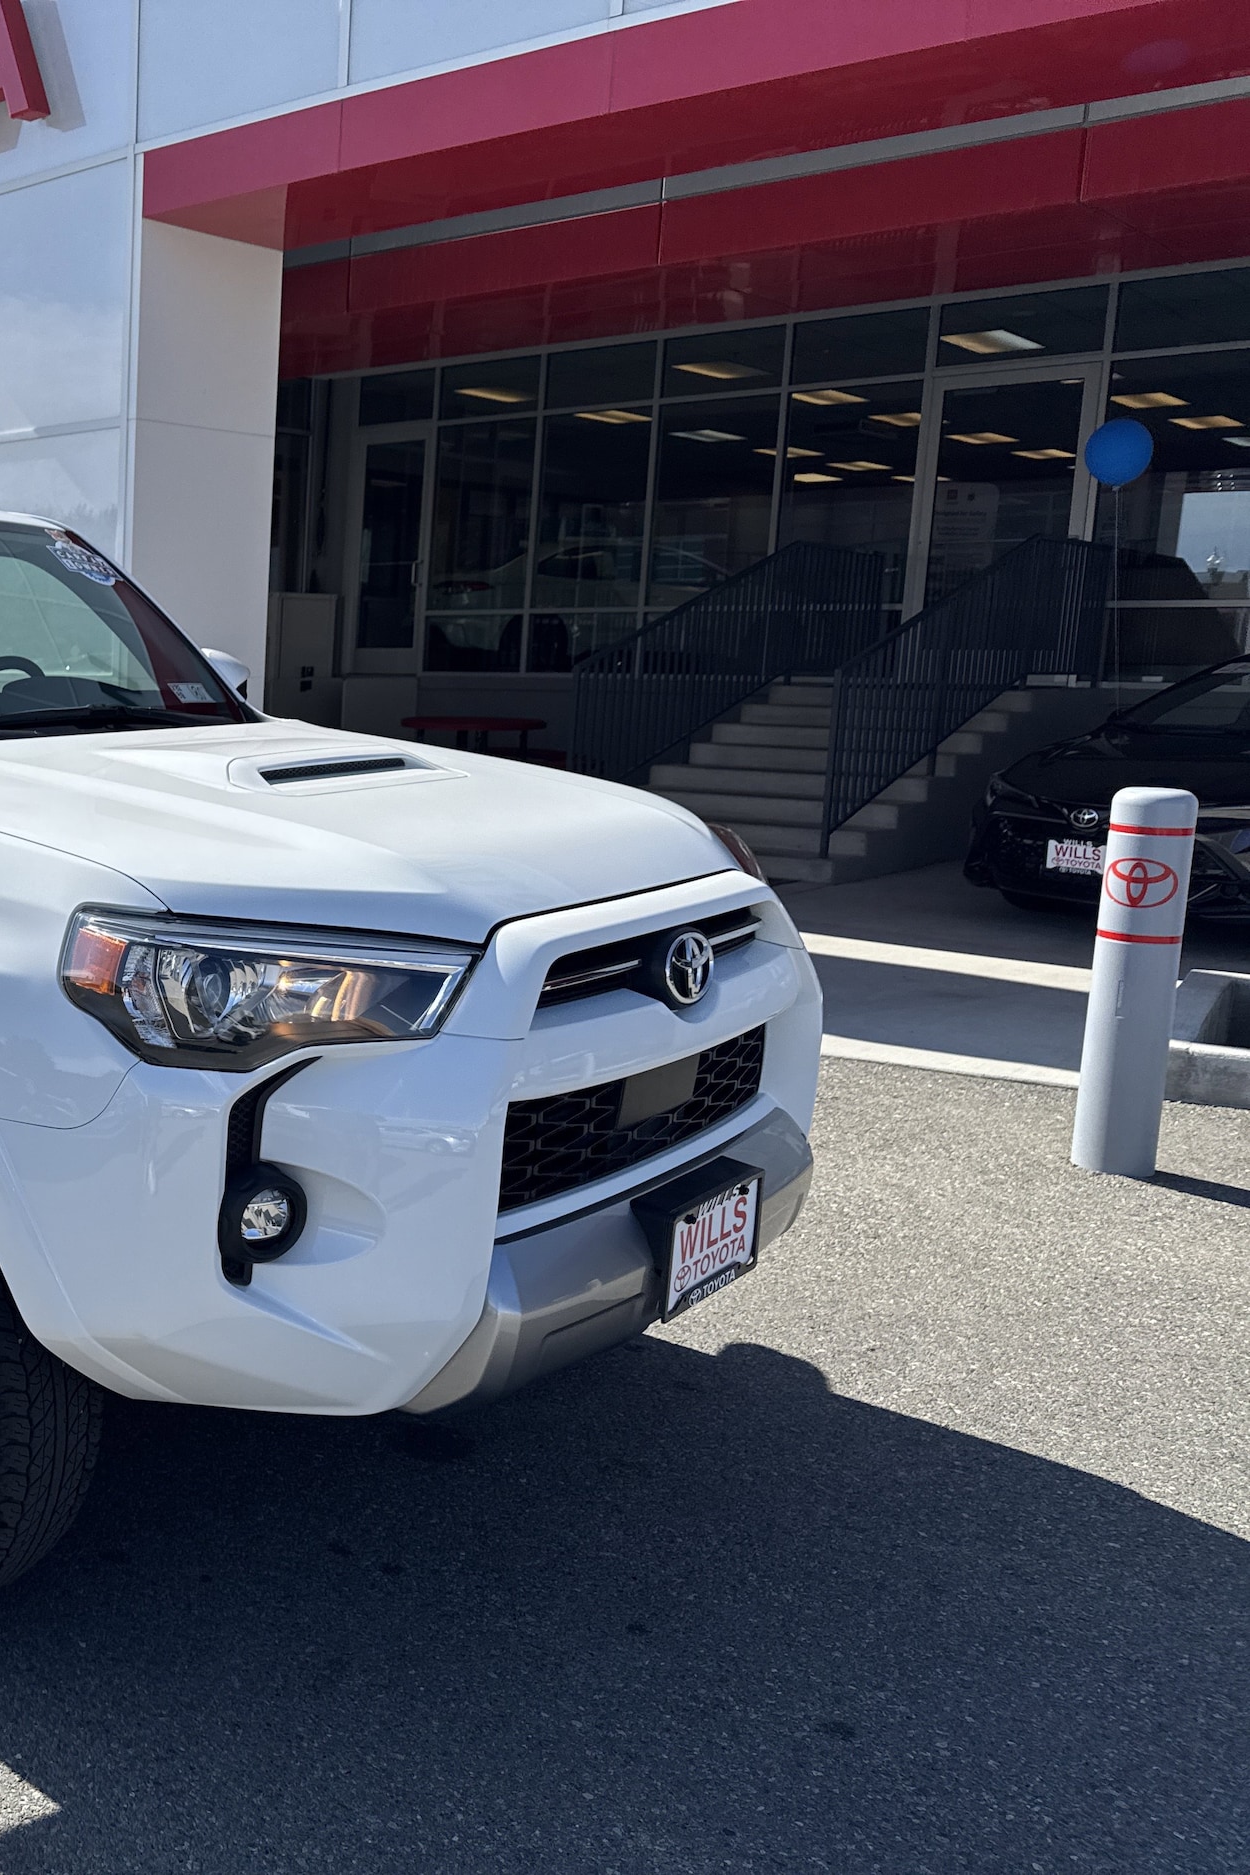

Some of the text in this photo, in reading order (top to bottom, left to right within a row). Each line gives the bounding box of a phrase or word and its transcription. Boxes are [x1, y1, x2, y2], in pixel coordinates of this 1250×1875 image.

[1055, 844, 1101, 861] WILLS
[1065, 859, 1102, 870] TOYOTA
[680, 1197, 748, 1264] WILLS
[692, 1234, 746, 1281] TOYOTA
[702, 1268, 737, 1297] TOYOTA
